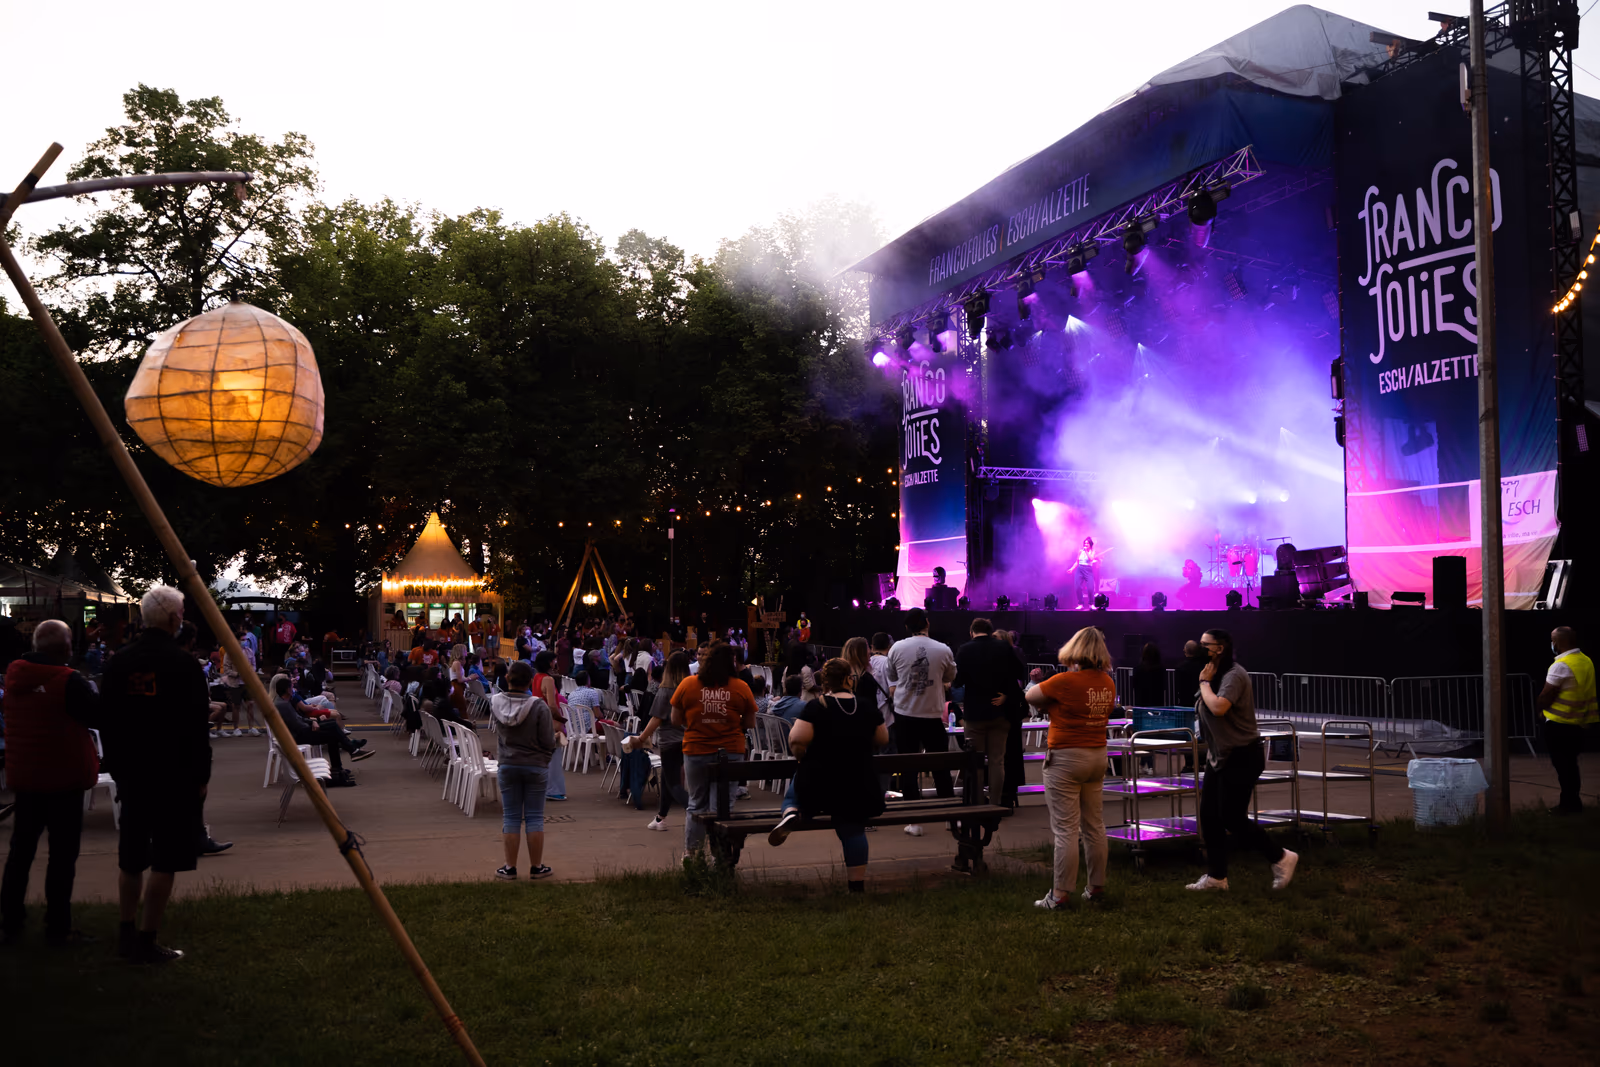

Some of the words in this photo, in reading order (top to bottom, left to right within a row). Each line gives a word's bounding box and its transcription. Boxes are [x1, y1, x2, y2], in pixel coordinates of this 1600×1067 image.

[929, 223, 999, 287] FRANCOFOLIES
[1007, 173, 1091, 247] ESCH/ALZETTE
[1508, 499, 1541, 517] ESCH
